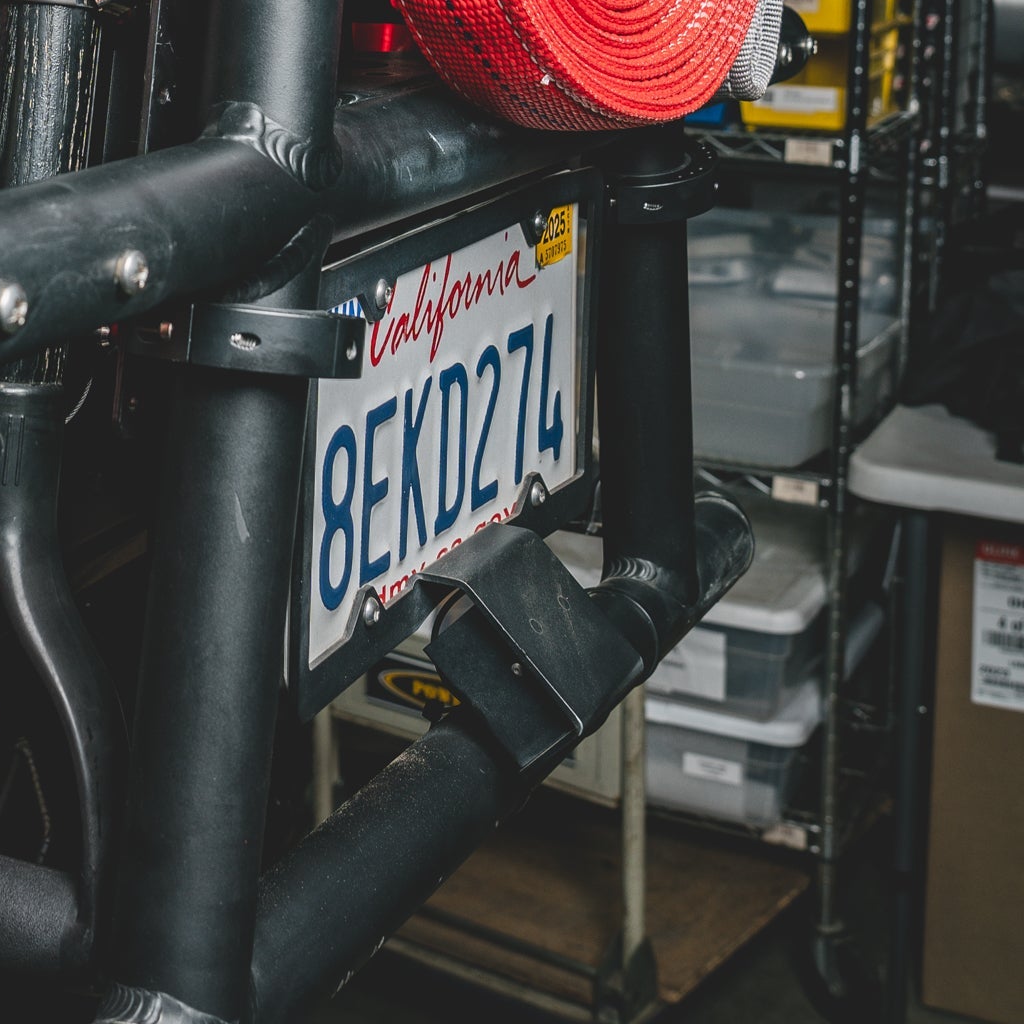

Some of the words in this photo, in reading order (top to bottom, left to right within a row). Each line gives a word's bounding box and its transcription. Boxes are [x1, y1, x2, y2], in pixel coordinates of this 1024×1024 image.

[543, 209, 566, 245] 2025
[370, 230, 536, 367] California
[319, 313, 564, 611] 8EKD274
